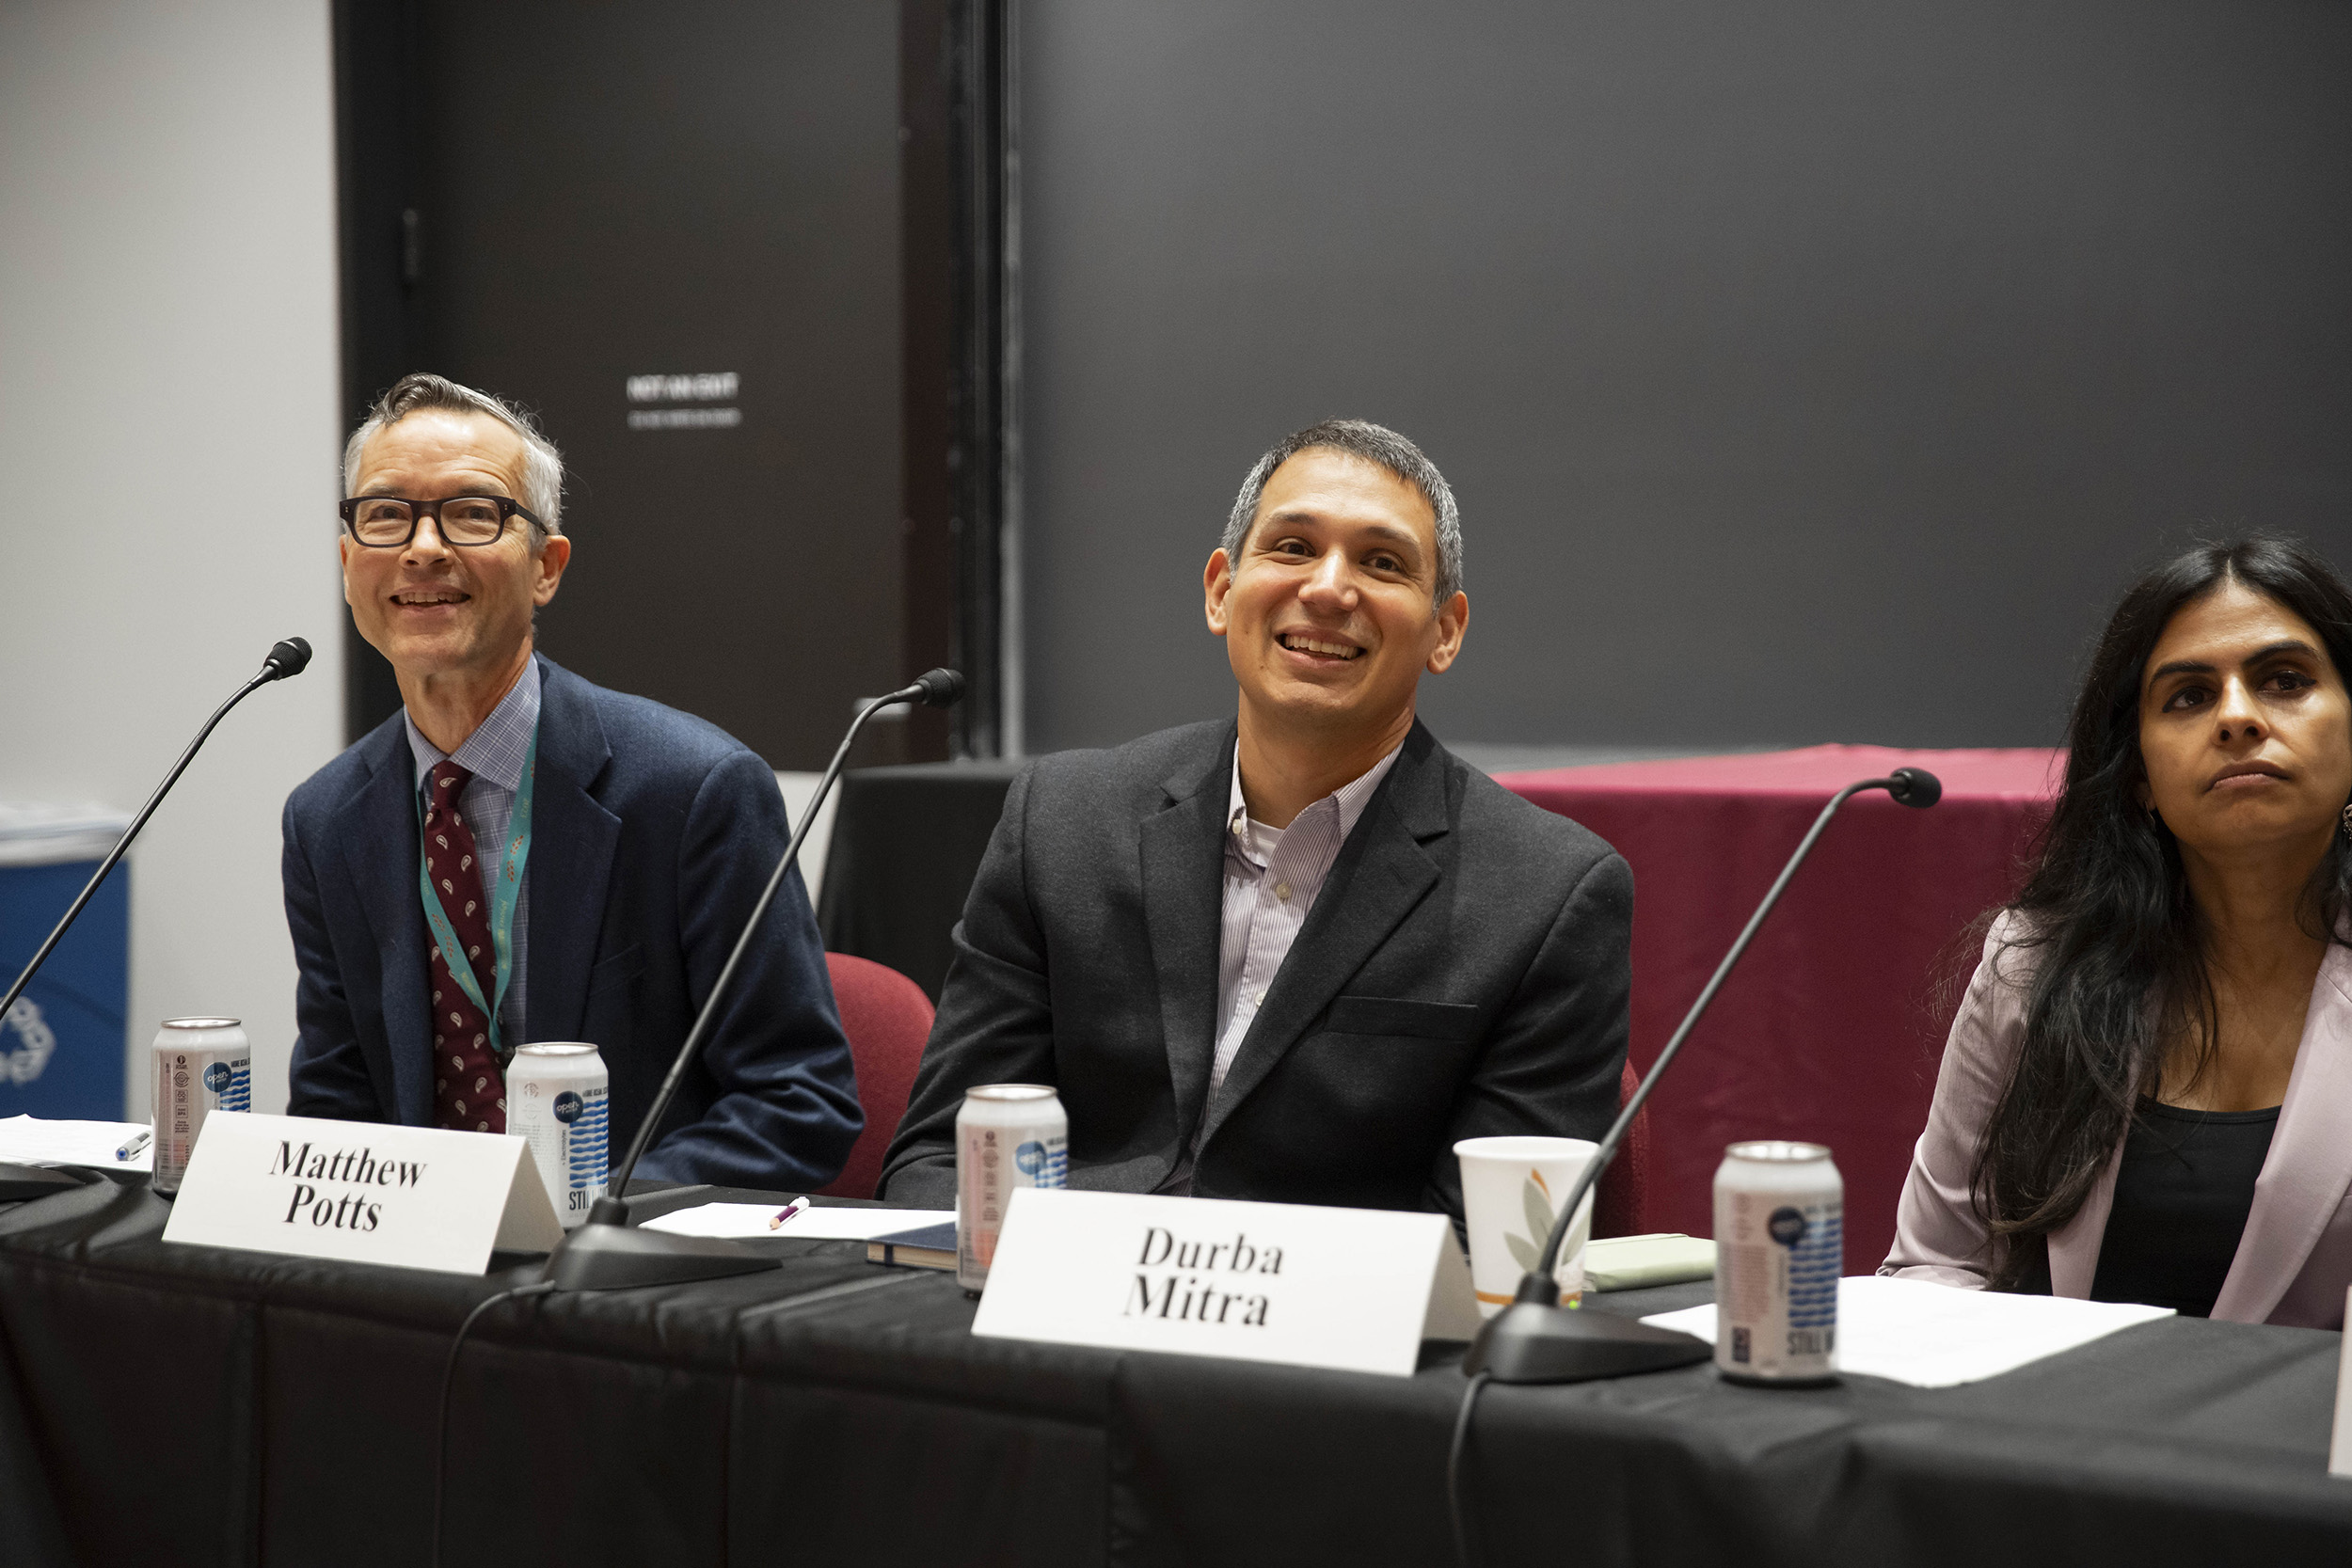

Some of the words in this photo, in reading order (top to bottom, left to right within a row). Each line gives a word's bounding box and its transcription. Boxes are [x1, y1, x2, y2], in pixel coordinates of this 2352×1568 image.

[207, 1071, 229, 1085] open
[557, 1101, 580, 1114] open
[267, 1140, 428, 1188] Matthew
[282, 1183, 382, 1231] Potts
[1136, 1227, 1282, 1274] Durba
[1120, 1273, 1268, 1326] Mitra
